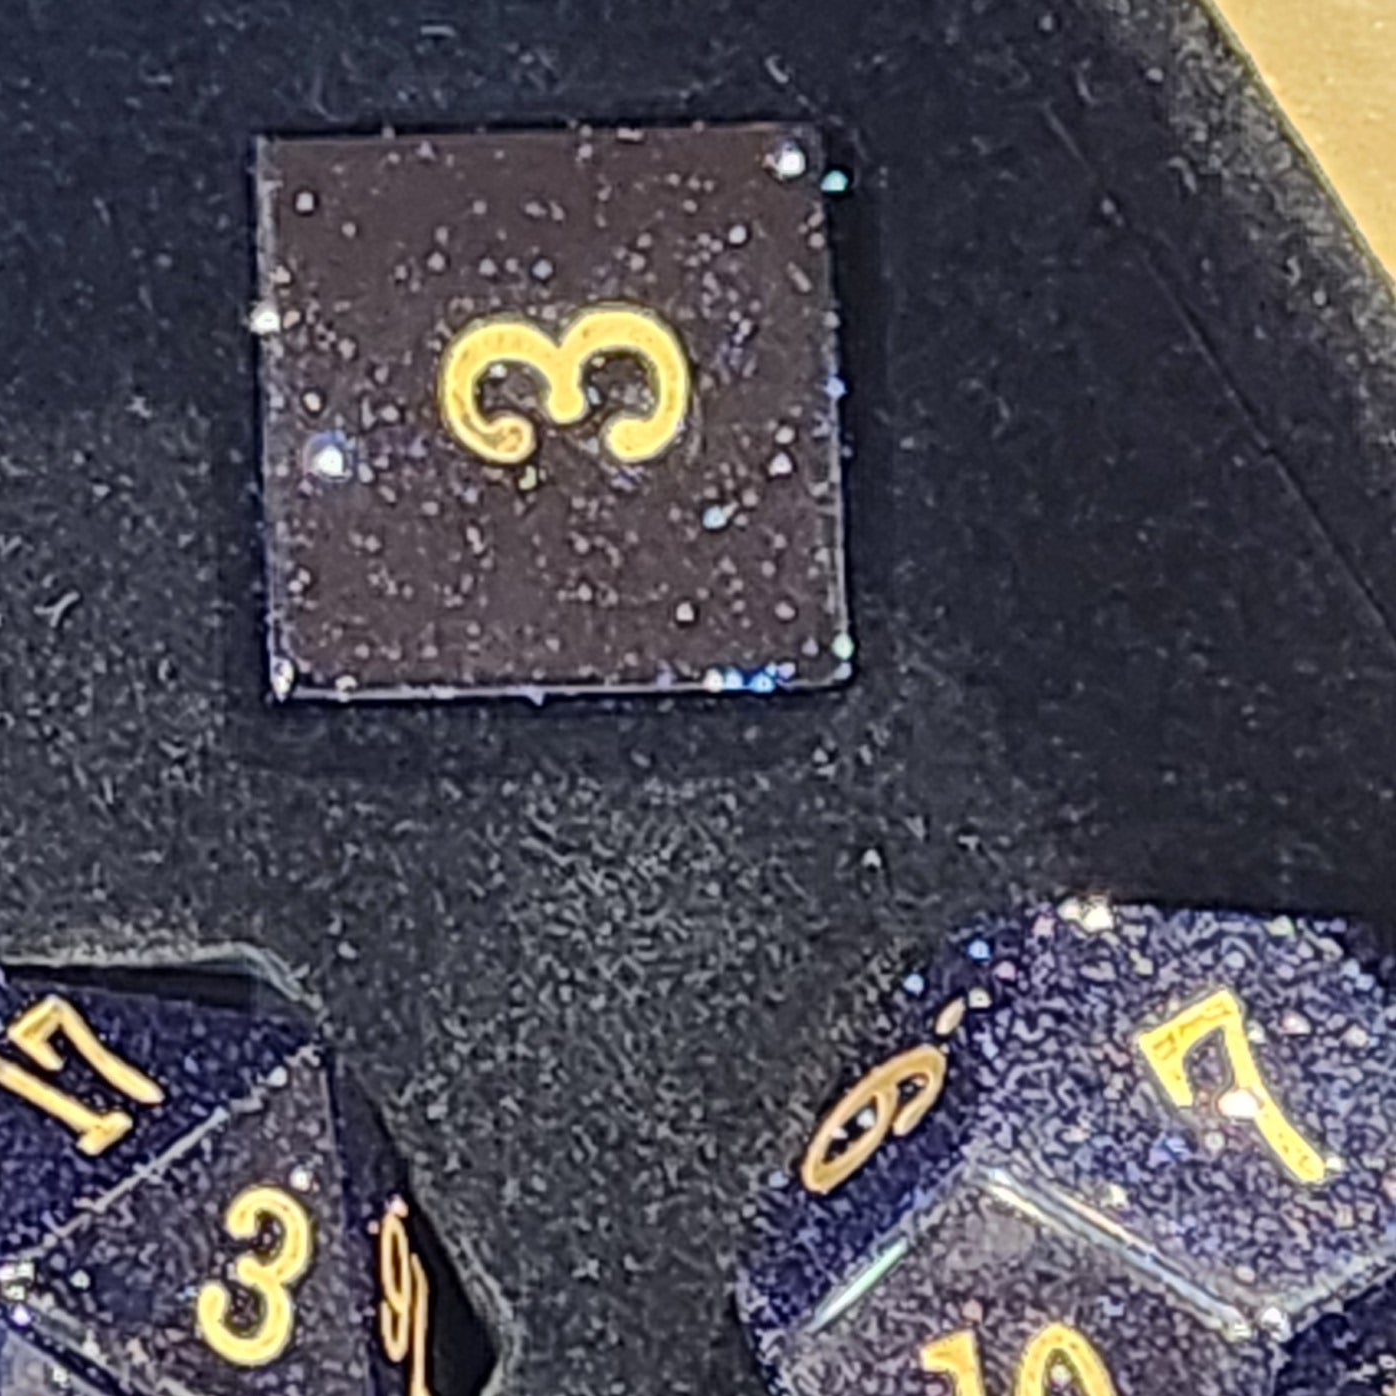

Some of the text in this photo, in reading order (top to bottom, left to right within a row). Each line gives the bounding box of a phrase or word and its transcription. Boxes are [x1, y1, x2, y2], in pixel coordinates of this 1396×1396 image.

[438, 304, 691, 463] 3
[1136, 988, 1328, 1184] 7
[197, 1186, 314, 1366] 3
